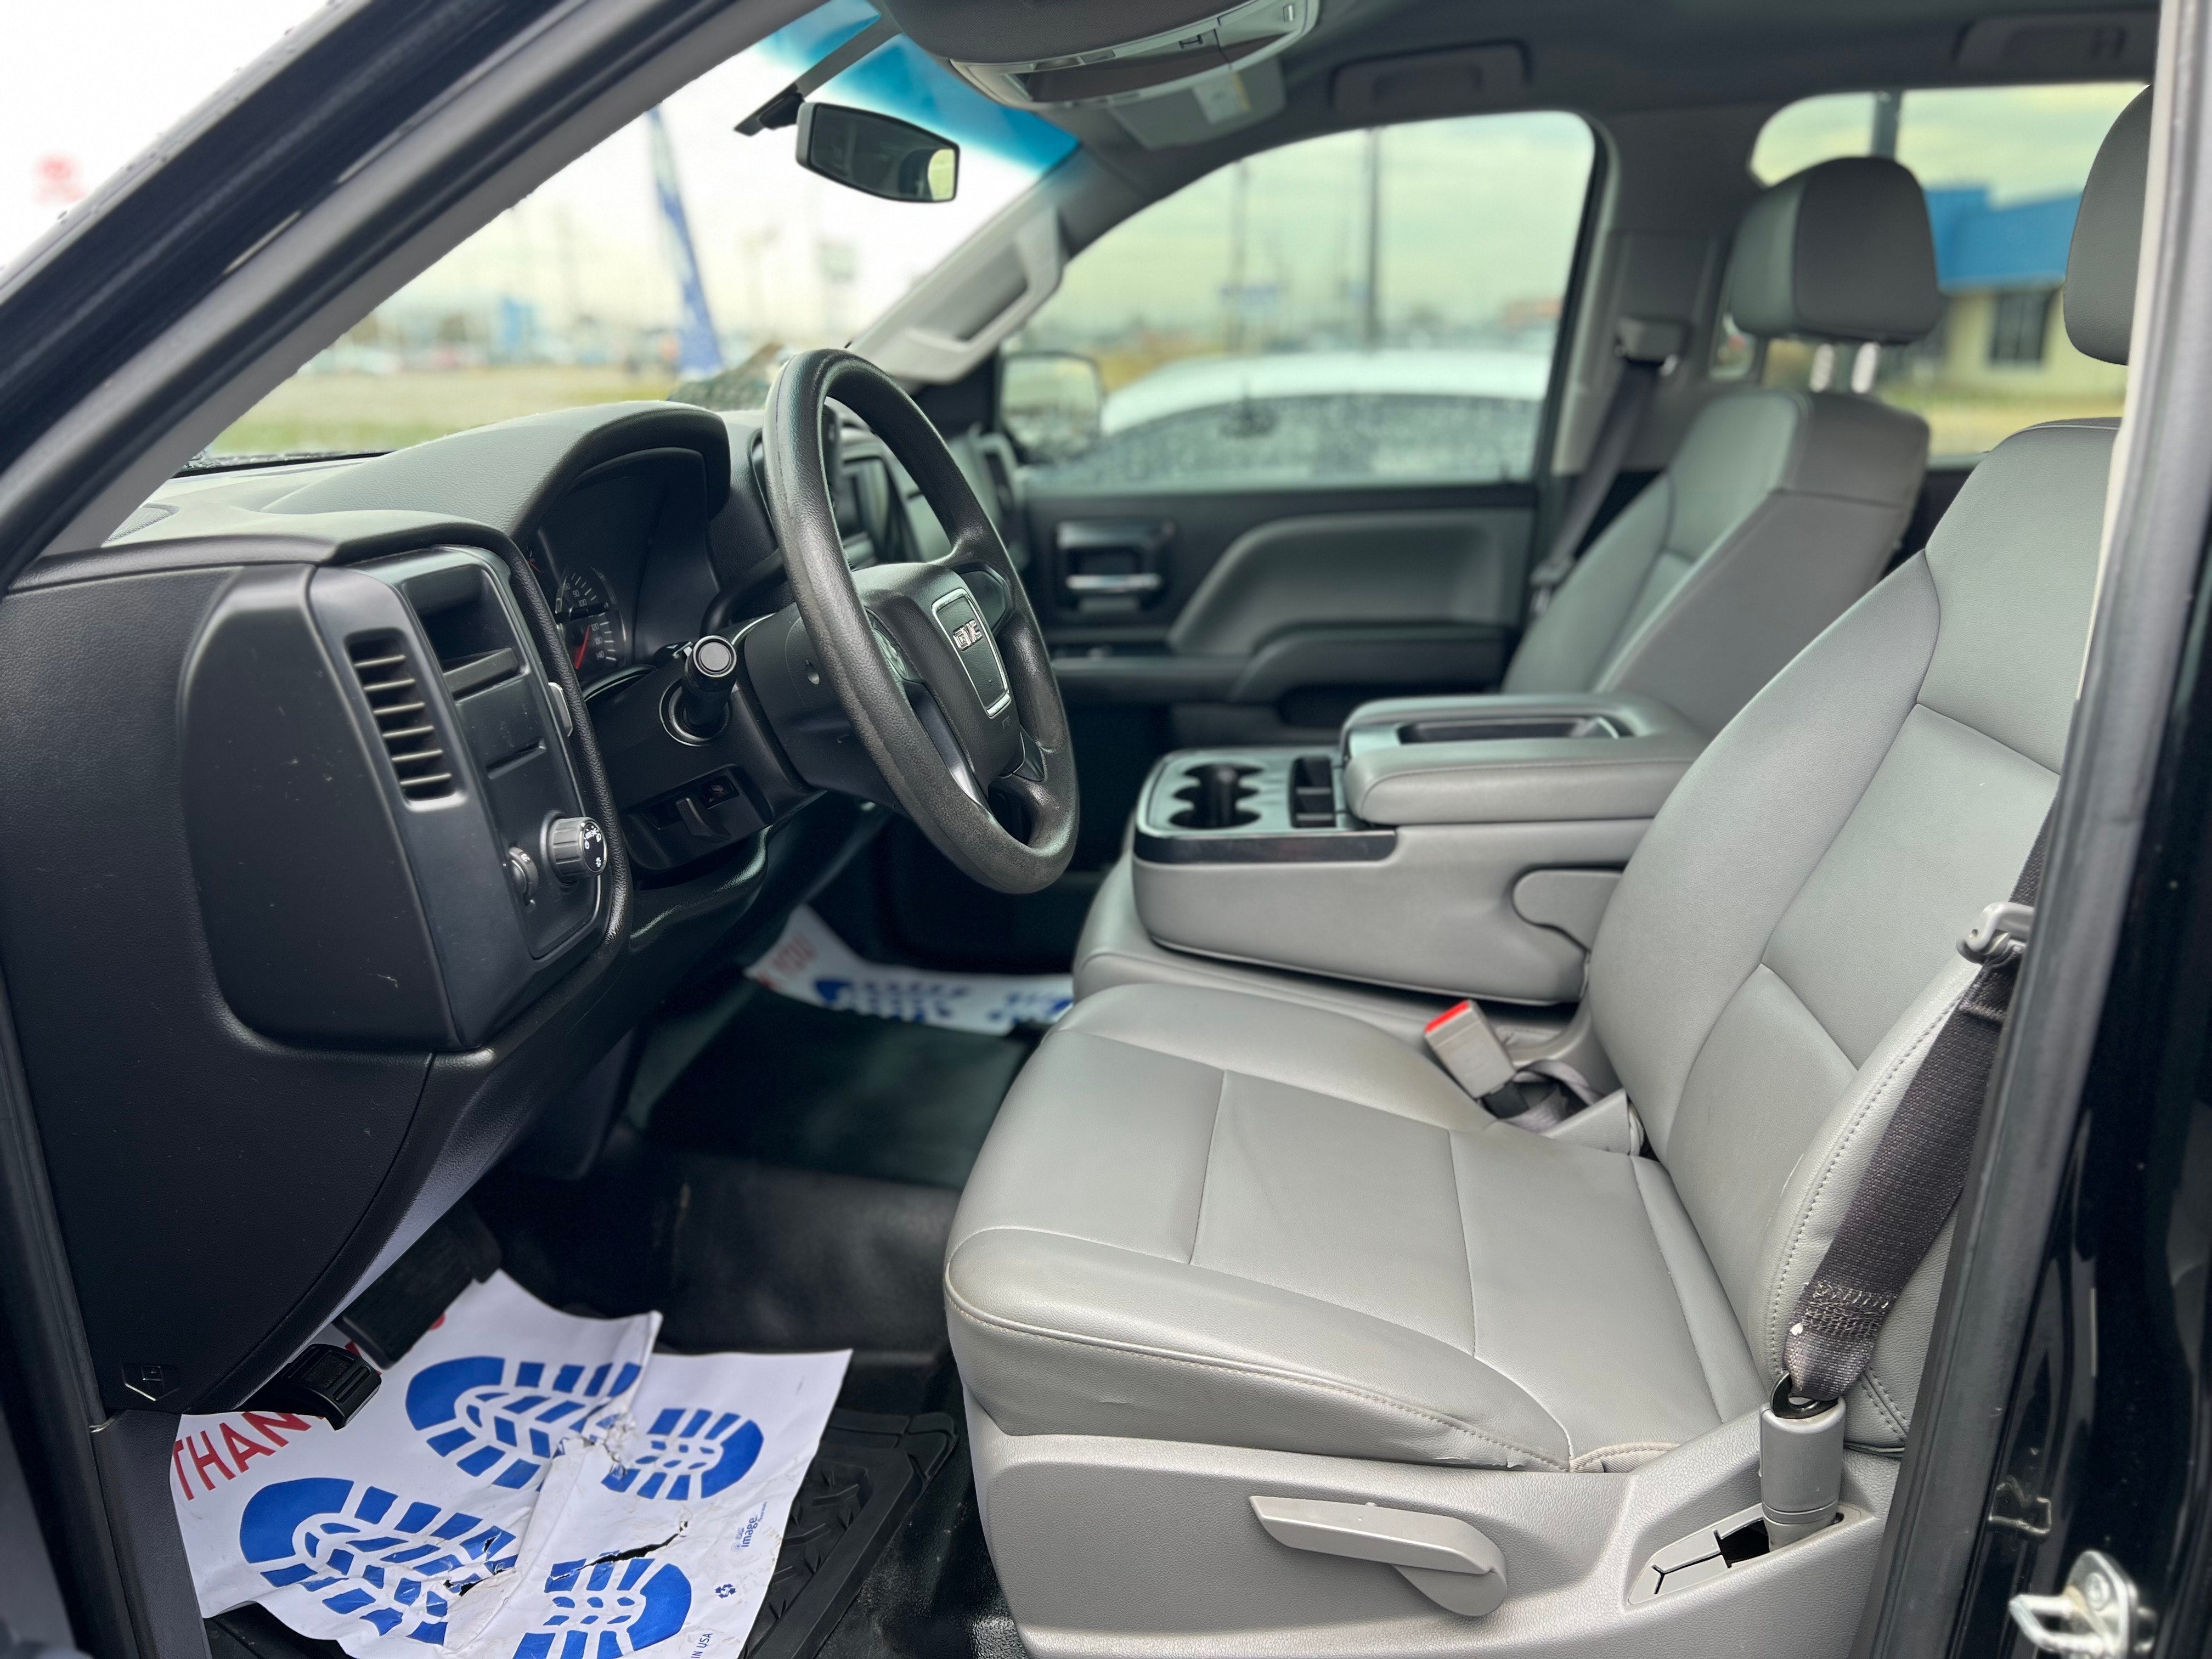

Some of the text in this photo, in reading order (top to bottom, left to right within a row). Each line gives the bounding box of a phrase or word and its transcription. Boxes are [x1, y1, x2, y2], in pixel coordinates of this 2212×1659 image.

[572, 589, 580, 597] 90
[578, 599, 587, 607] 100
[591, 623, 599, 631] 120
[173, 1412, 324, 1500] THAN
[737, 1515, 758, 1548] image
[696, 1633, 713, 1648] USA
